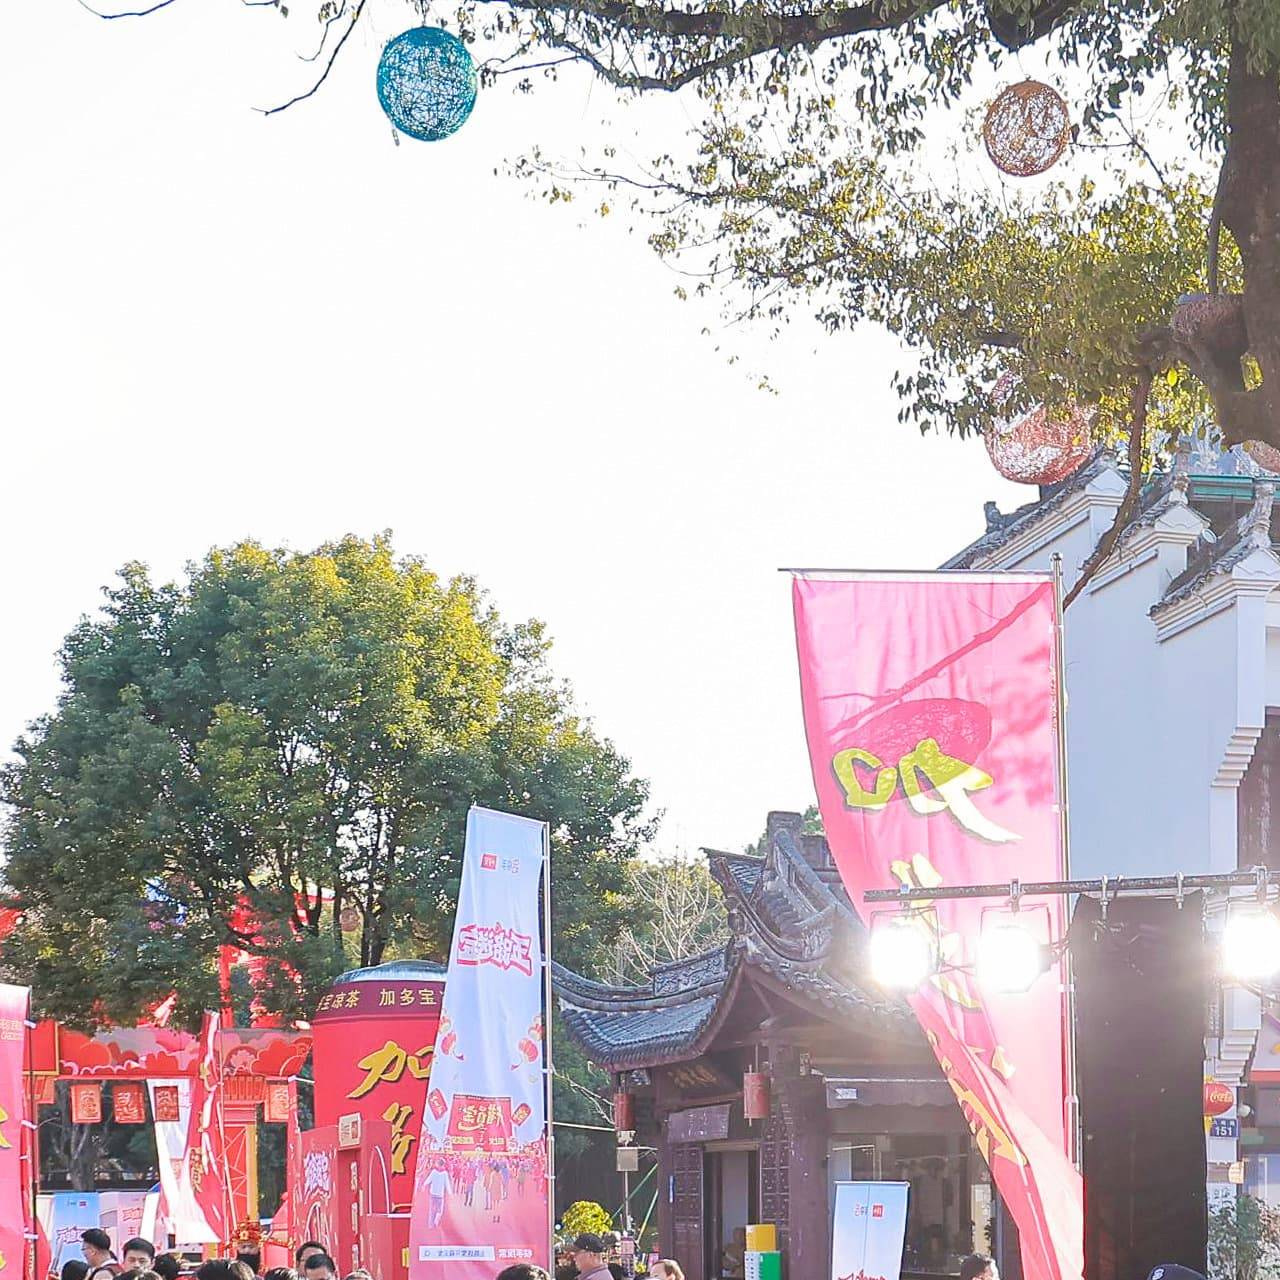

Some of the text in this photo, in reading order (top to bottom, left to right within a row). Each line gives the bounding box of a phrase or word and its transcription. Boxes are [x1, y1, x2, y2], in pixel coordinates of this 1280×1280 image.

[379, 988, 443, 1007] 加多宝
[1215, 1126, 1232, 1137] 151
